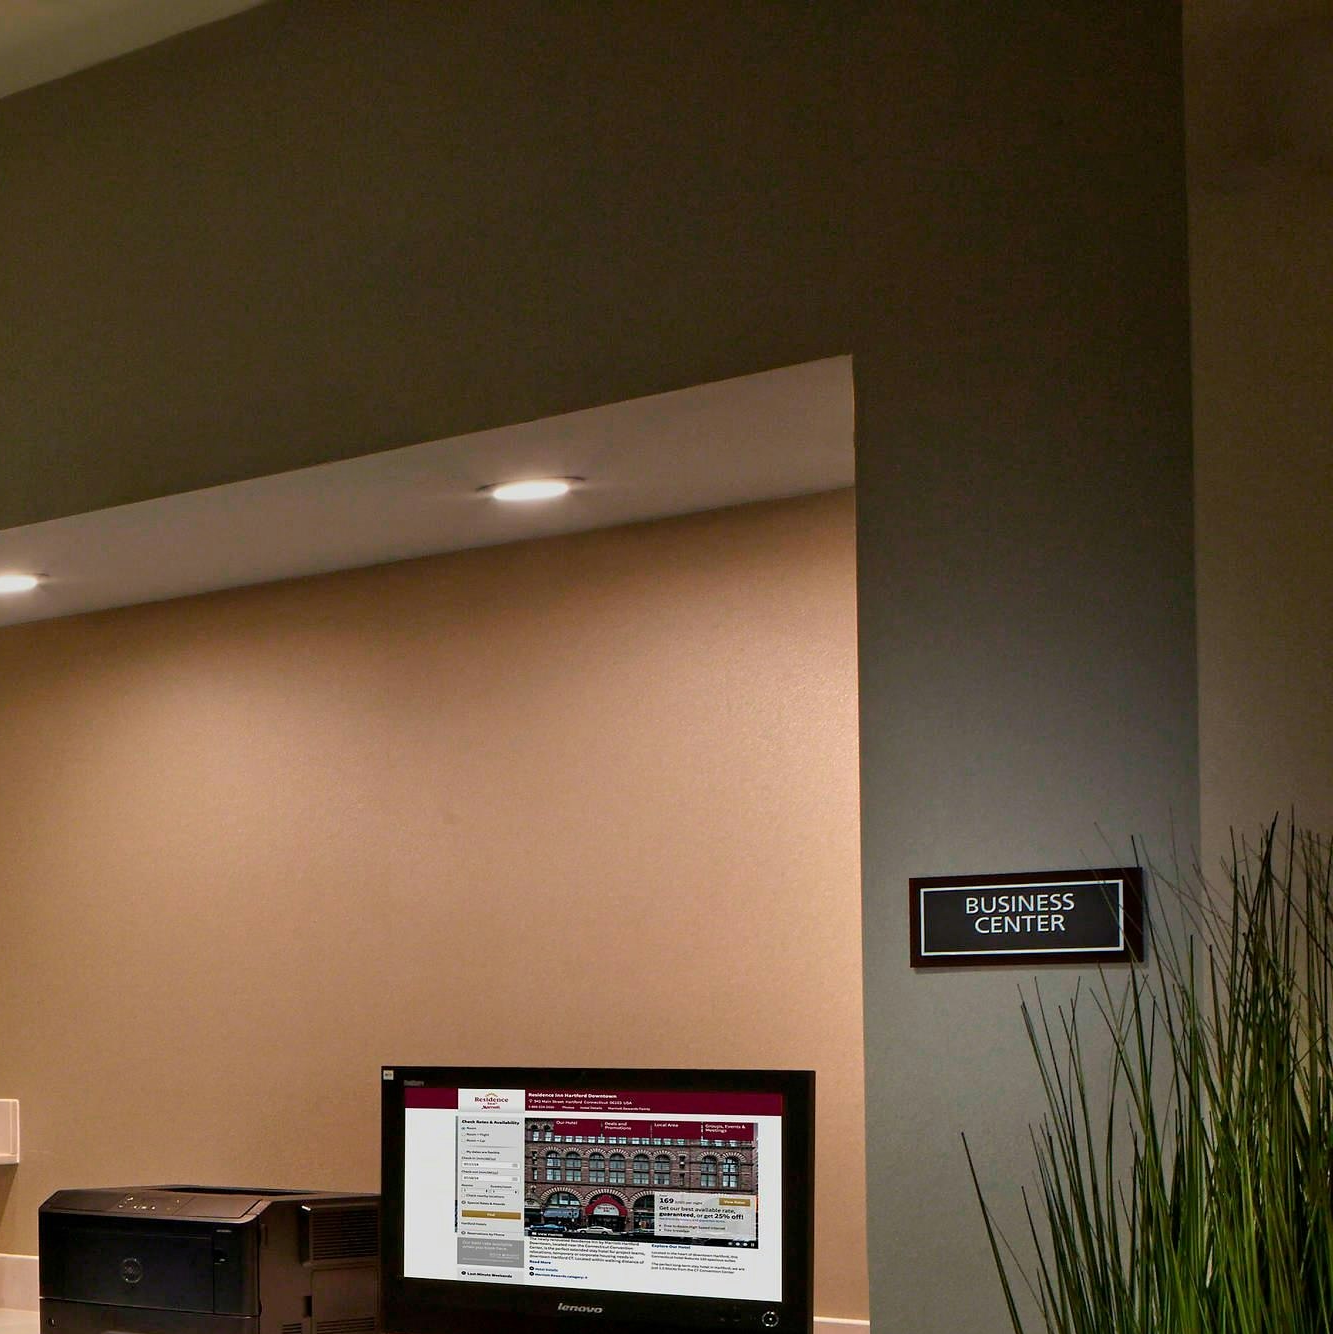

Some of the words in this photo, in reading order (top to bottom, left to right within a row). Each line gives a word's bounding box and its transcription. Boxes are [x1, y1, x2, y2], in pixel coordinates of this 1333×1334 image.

[965, 892, 1075, 914] BUSINESS
[974, 914, 1066, 934] CENTER
[558, 1302, 603, 1313] lenovo
